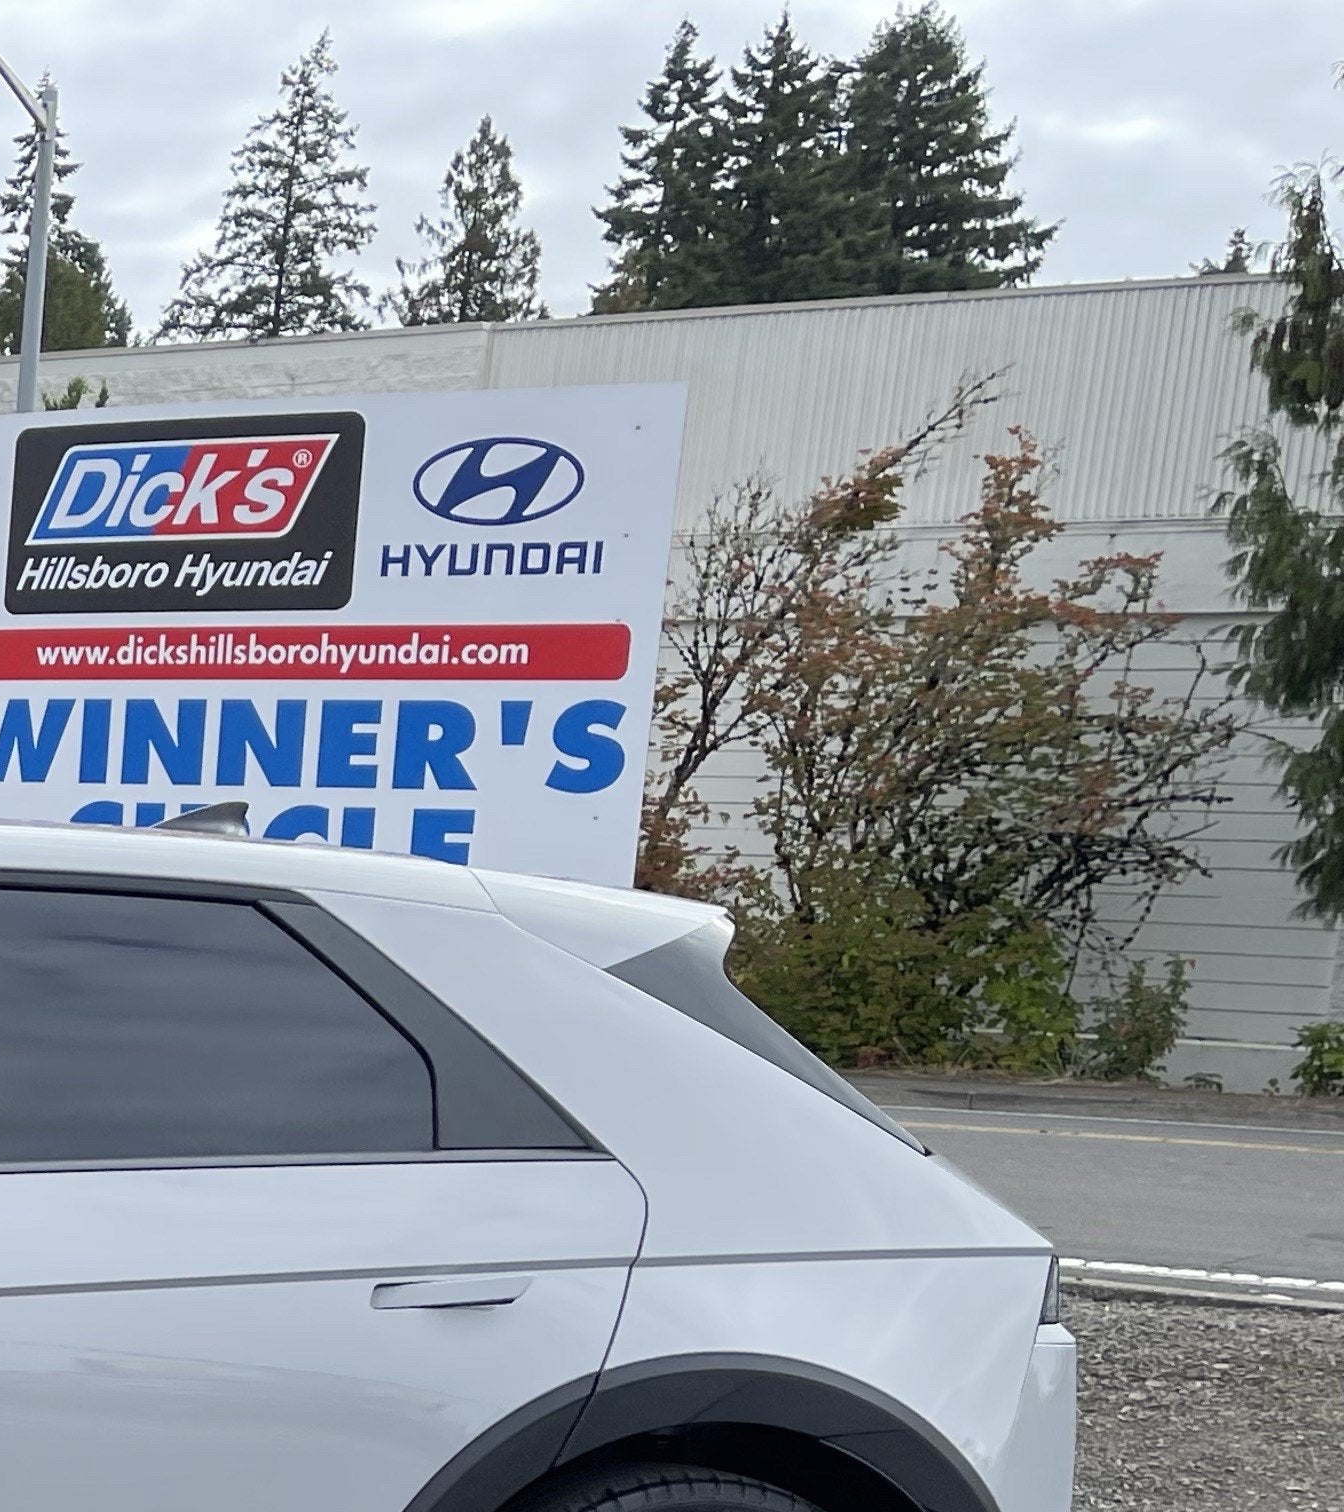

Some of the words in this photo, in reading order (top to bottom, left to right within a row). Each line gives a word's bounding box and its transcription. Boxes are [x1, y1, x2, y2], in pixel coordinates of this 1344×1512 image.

[48, 448, 295, 529] Dick's
[16, 556, 170, 591] Hillsboro
[174, 551, 334, 597] Hyundai
[380, 540, 604, 577] HYUNDAI
[36, 632, 529, 669] www.dickshillsborohyundai.com
